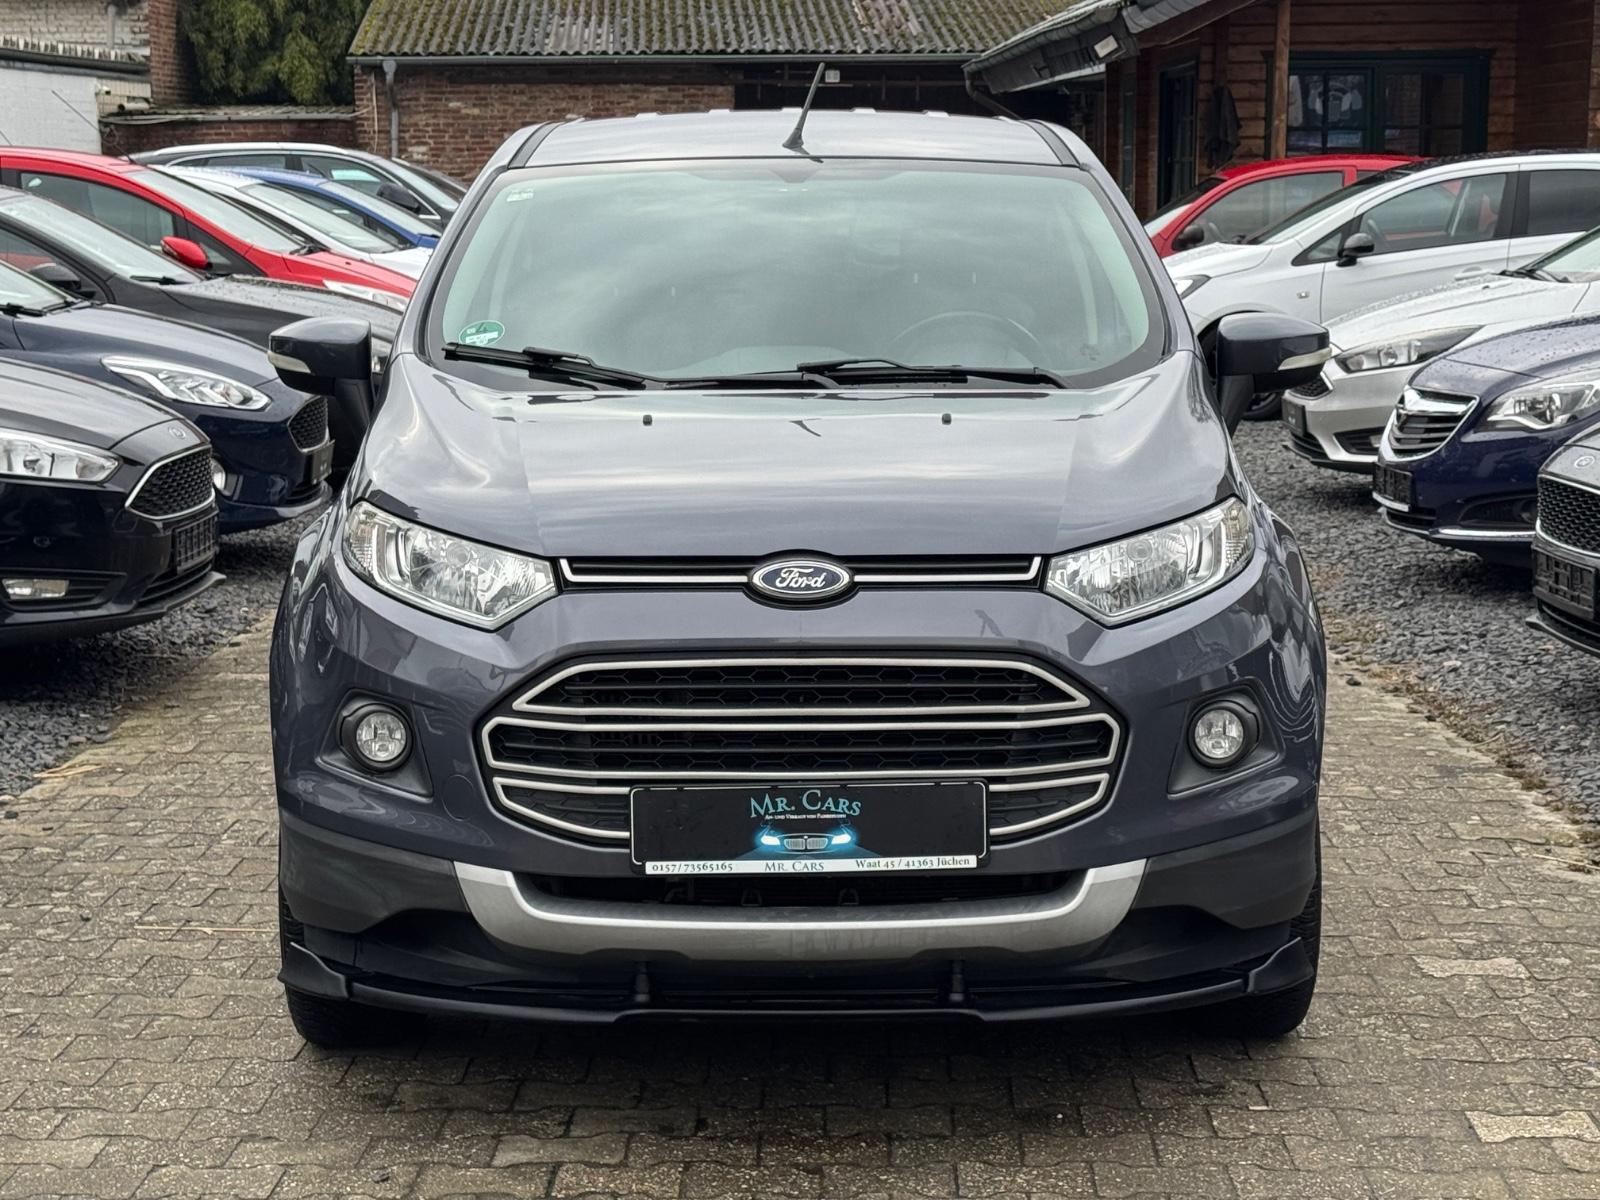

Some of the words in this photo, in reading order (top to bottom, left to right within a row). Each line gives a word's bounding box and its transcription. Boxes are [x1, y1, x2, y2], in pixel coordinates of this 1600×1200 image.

[775, 567, 827, 588] Ford
[802, 789, 861, 816] CARS
[652, 862, 733, 873] 0157/73565165
[792, 860, 825, 872] CARS
[856, 859, 881, 869] Waat
[884, 860, 895, 869] 45
[904, 858, 934, 869] 41363
[937, 857, 970, 867] Jüchen
